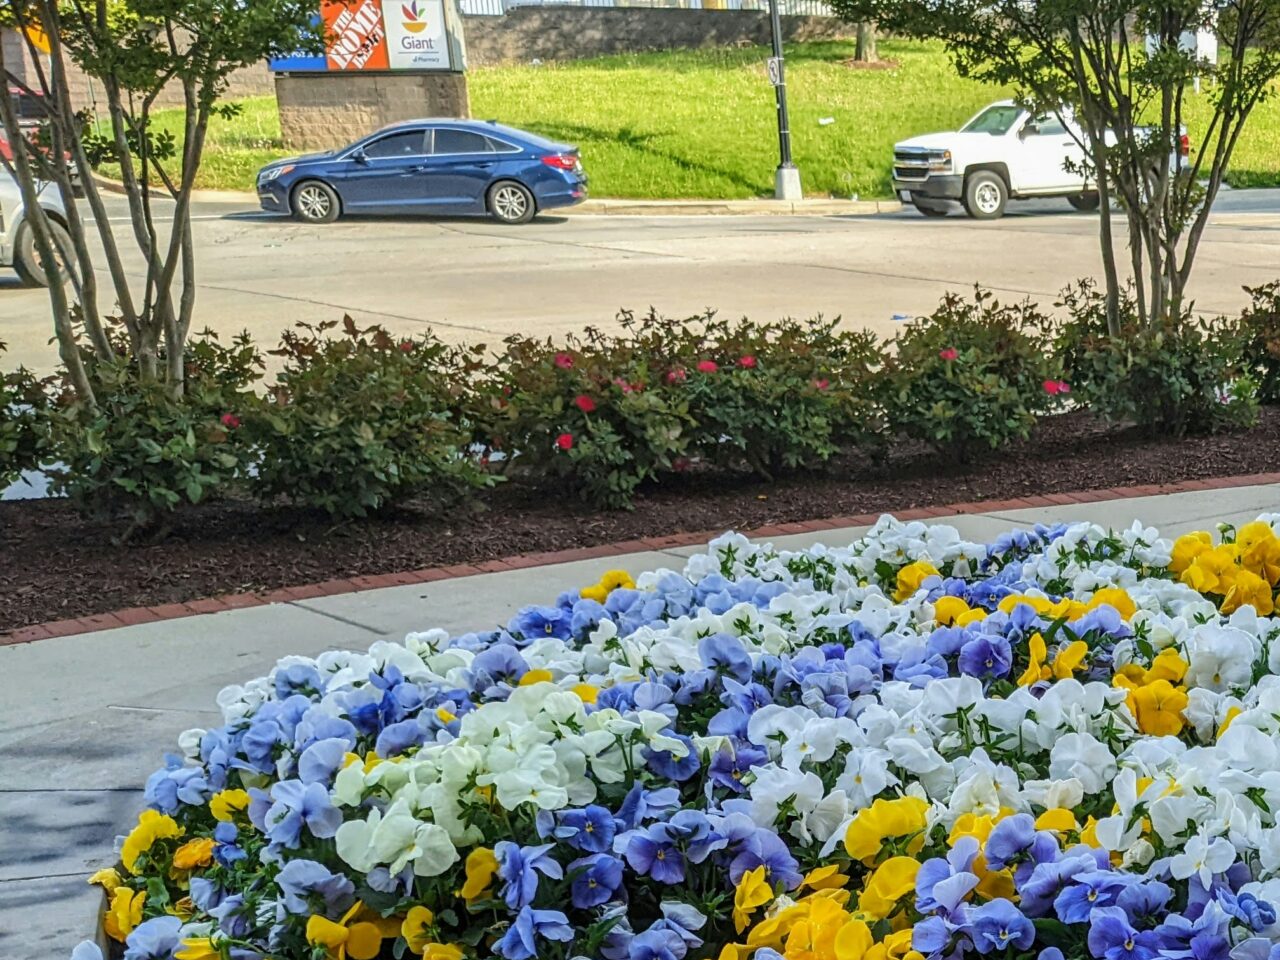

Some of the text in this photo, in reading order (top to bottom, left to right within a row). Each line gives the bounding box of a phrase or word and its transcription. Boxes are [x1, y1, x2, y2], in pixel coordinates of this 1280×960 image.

[328, 0, 382, 70] HOME
[332, 8, 354, 35] THE
[401, 36, 434, 50] Giant
